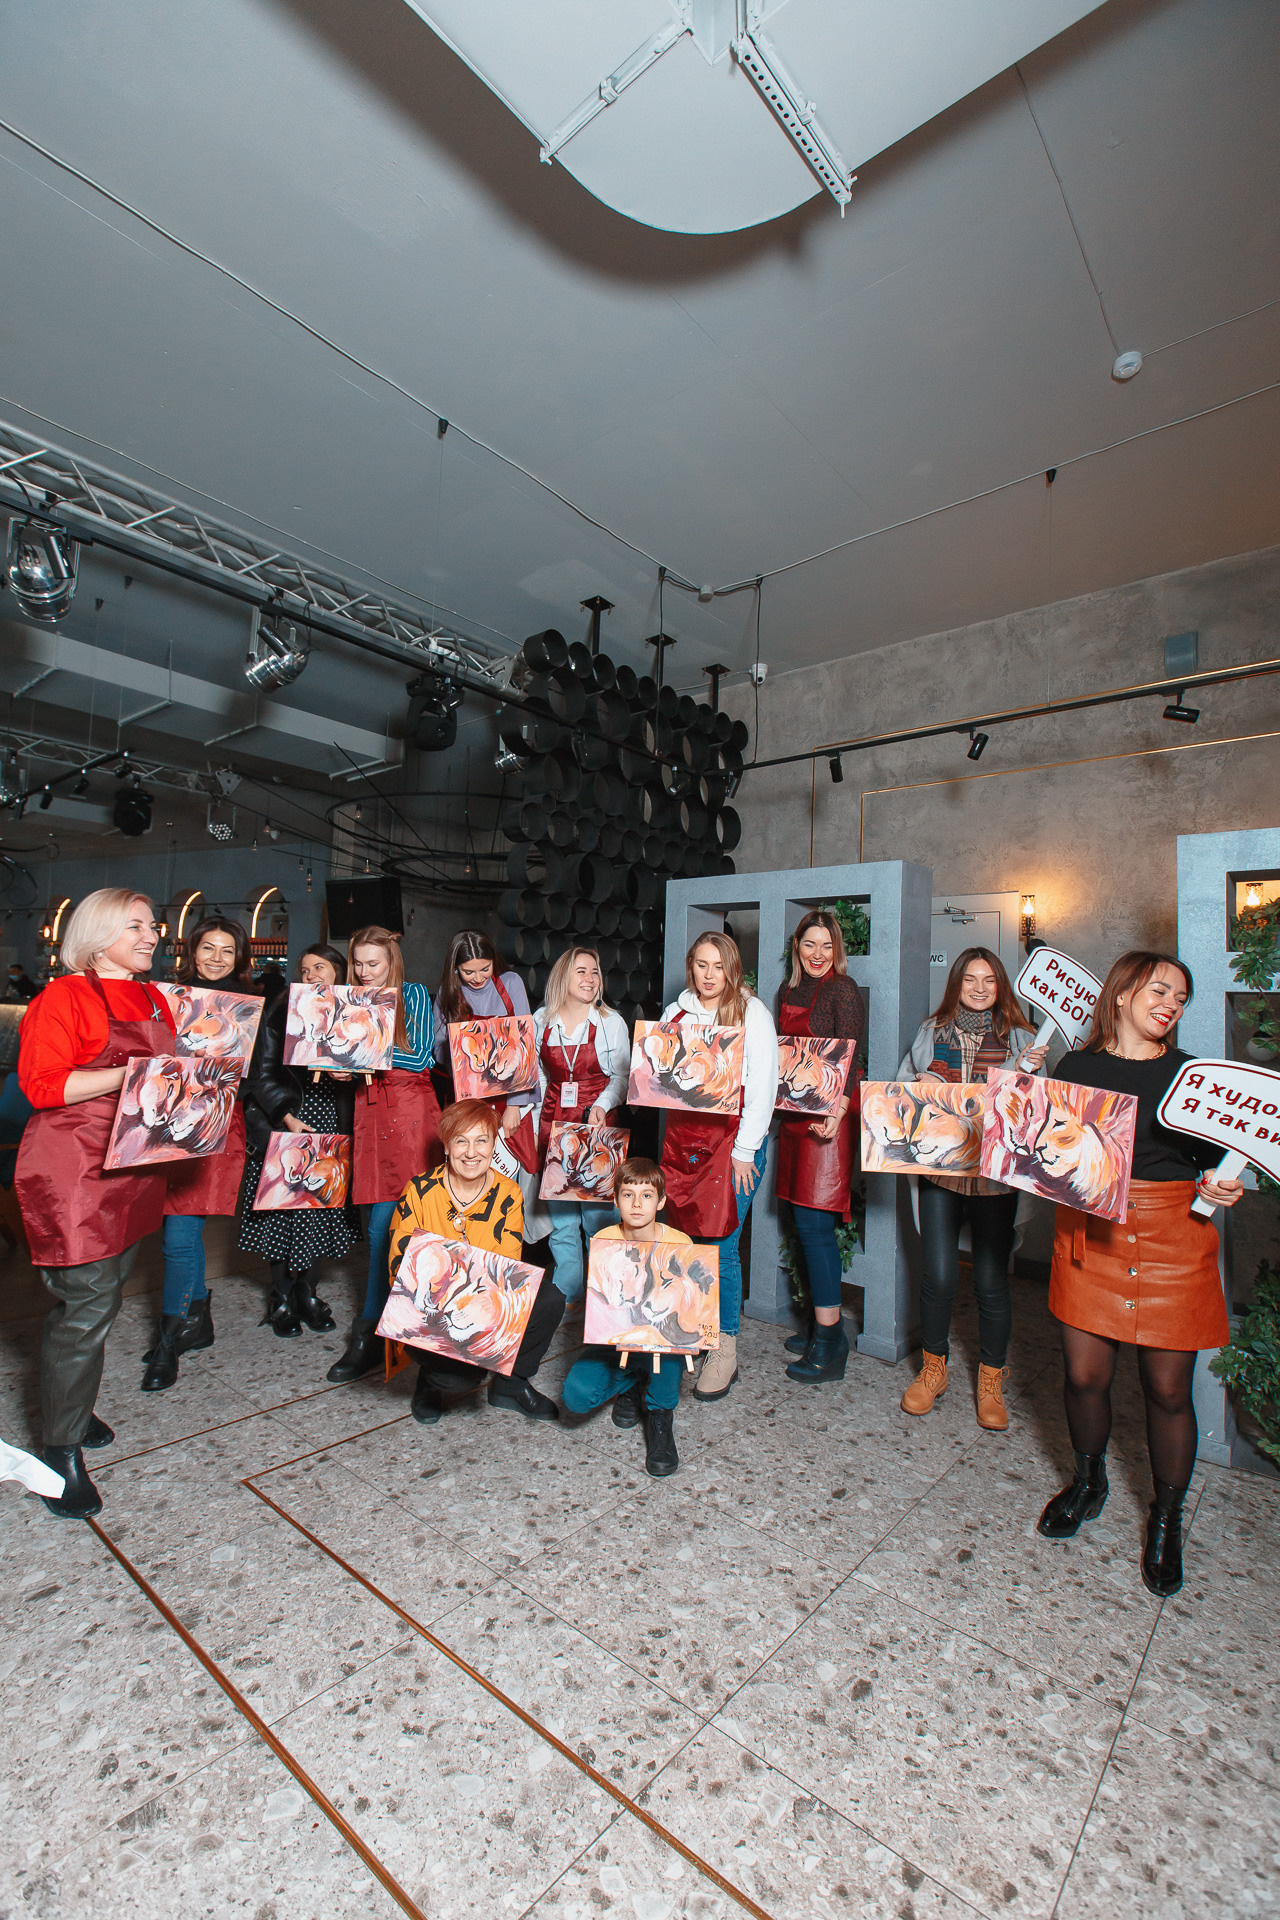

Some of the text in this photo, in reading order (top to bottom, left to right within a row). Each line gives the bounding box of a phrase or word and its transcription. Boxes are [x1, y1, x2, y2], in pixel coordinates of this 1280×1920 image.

[1029, 974, 1094, 1027] как БОГ
[1045, 958, 1097, 1006] Рисую
[1181, 1097, 1202, 1114] Я
[1206, 1106, 1251, 1133] так
[1185, 1073, 1280, 1119] Я худо
[500, 1163, 510, 1176] Не
